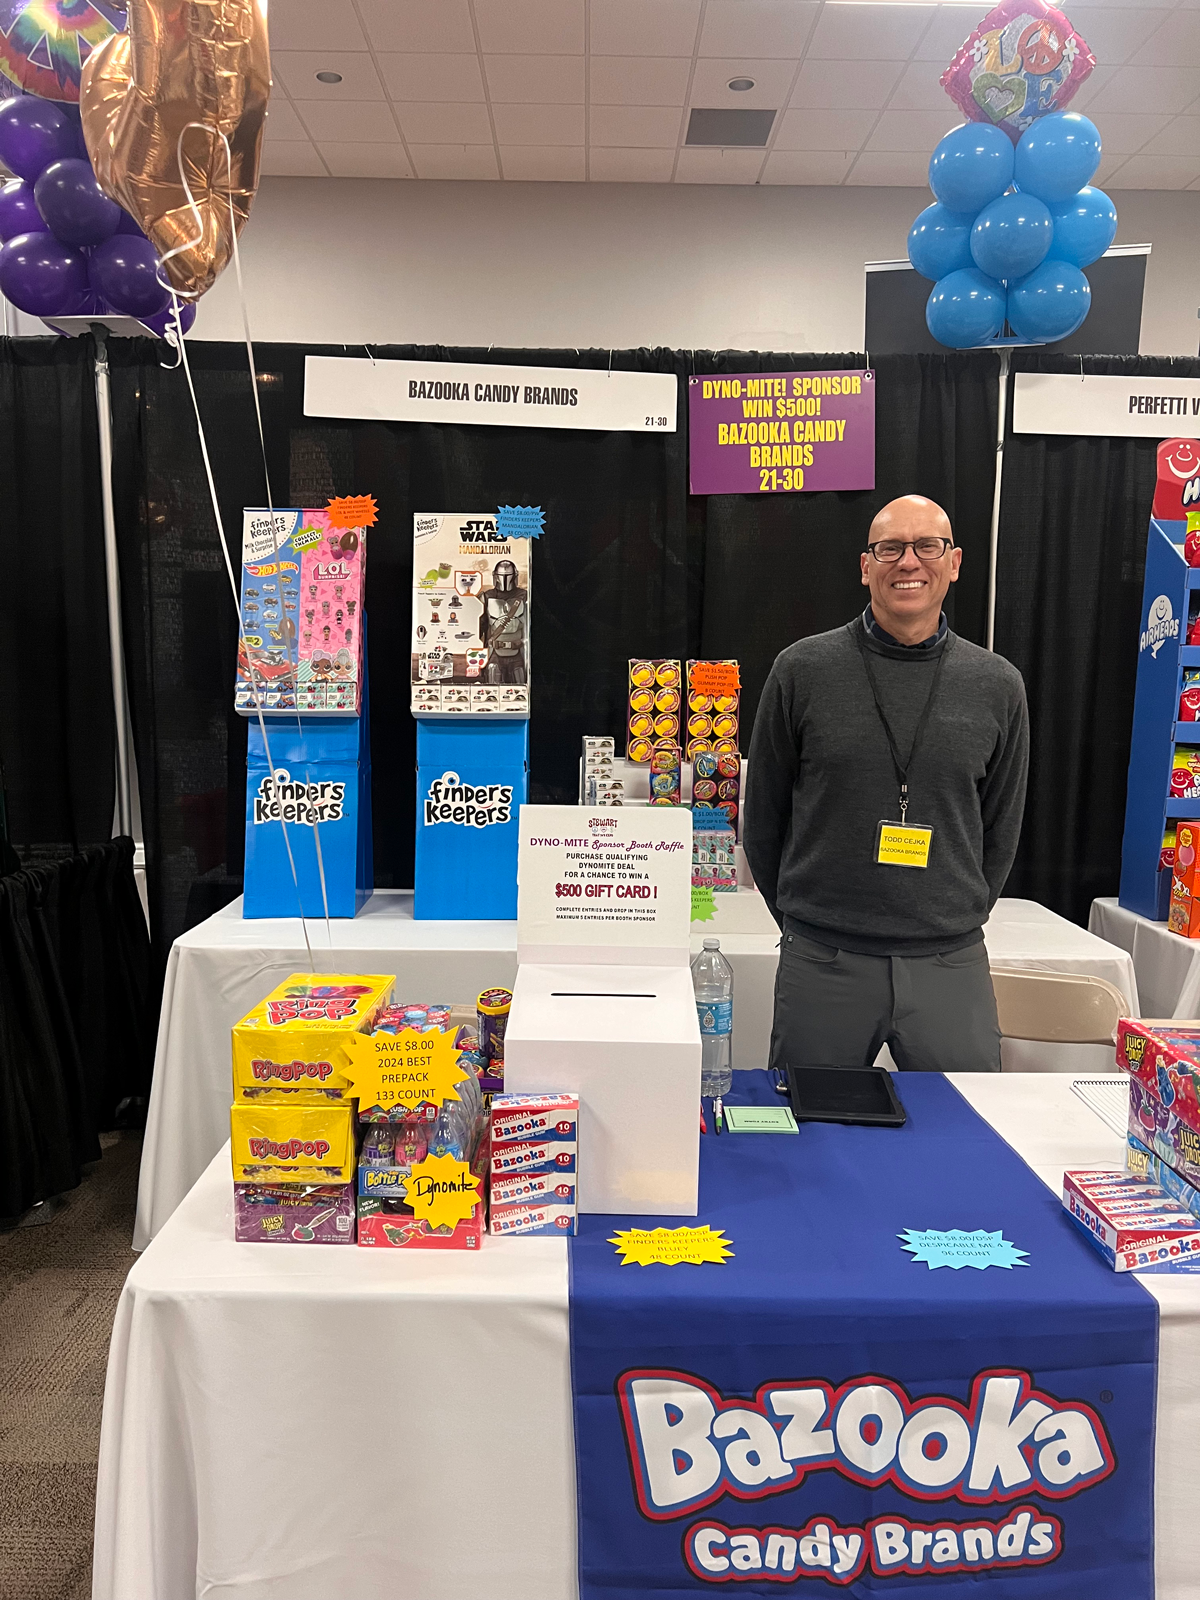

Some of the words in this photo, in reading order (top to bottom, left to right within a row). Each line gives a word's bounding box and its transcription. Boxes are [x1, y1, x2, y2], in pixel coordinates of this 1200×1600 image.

[408, 380, 470, 401] BAZOOKA
[474, 383, 520, 404] CANDY
[523, 386, 579, 407] BRANDS
[702, 378, 787, 399] DYNO-MITE!
[793, 376, 862, 396] SPONSOR
[742, 399, 773, 418] WIN
[776, 397, 822, 418] $500!
[1128, 395, 1188, 415] PERFETTI
[645, 416, 668, 427] 21-30
[718, 421, 791, 445] BAZOOKA
[793, 419, 847, 443] CANDY
[750, 444, 814, 467] BRANDS
[759, 467, 804, 491] 21-30
[459, 520, 500, 531] STA
[254, 536, 275, 547] Chocolat
[459, 545, 511, 554] MANDALORIAN
[1140, 619, 1180, 652] AIRHEADS
[588, 818, 618, 828] STEWART
[530, 838, 589, 847] DYNO-MITE
[591, 839, 625, 850] Sponsor
[625, 840, 653, 852] Booth
[655, 841, 685, 852] Raffle
[903, 837, 926, 846] CEJKA
[555, 882, 583, 898] $500
[584, 884, 614, 898] GIFT
[615, 885, 651, 898] CARD
[375, 1042, 402, 1053] SAVE
[405, 1040, 435, 1052] $8.00
[1125, 1035, 1147, 1054] JUICY
[377, 1057, 404, 1068] 2024
[407, 1056, 432, 1067] BEST
[381, 1072, 430, 1084] PREPACK
[375, 1090, 395, 1100] 133
[397, 1088, 436, 1099] COUNT
[494, 1111, 533, 1125] ORIGINAL
[493, 1117, 547, 1138] Bazooka
[558, 1123, 570, 1131] 10
[1180, 1129, 1200, 1149] JUIC
[493, 1143, 532, 1157] ORIGINAL
[493, 1149, 546, 1170] Bazooka
[413, 1172, 476, 1206] Dynomite
[493, 1175, 532, 1188] ORIGINAL
[492, 1181, 546, 1201] Bazooka
[359, 1202, 380, 1212] FLAVOR!
[493, 1206, 532, 1220] ORIGINAL
[261, 1215, 285, 1228] JUICY
[492, 1212, 545, 1232] Bazooka
[1069, 1194, 1106, 1241] Bazooka
[266, 1222, 282, 1232] DROP
[1123, 1234, 1169, 1251] ORIGINAL
[1124, 1239, 1200, 1268] Bazooka
[630, 1377, 1105, 1507] Bazooka
[694, 1524, 863, 1574] Candy
[874, 1512, 1053, 1568] Brands
